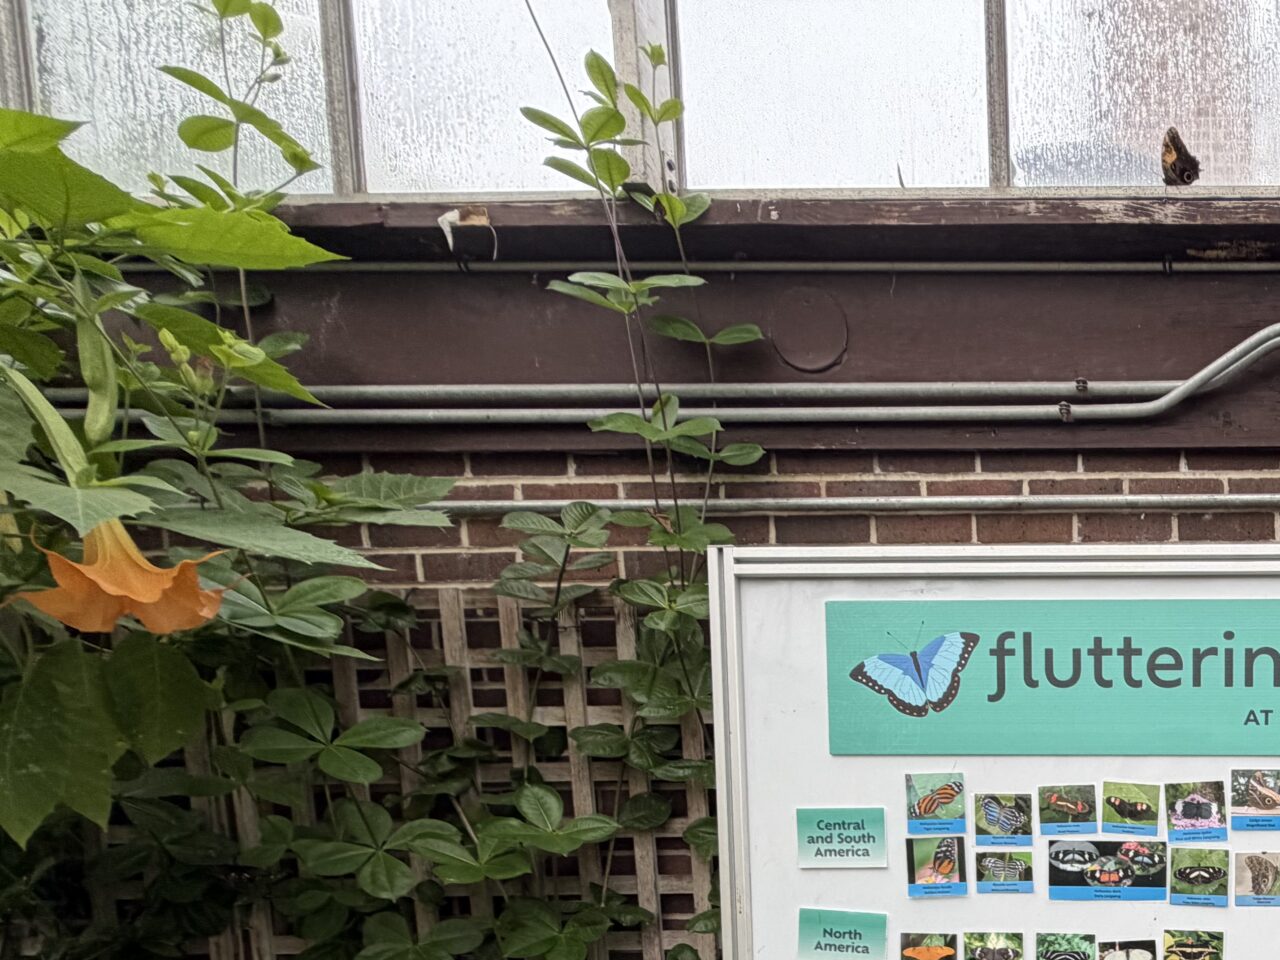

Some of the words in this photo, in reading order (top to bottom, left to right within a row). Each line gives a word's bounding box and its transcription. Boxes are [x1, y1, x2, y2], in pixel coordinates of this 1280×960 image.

[1244, 709, 1274, 726] AT
[816, 819, 866, 831] Central
[807, 833, 833, 844] and
[837, 833, 876, 844] South
[814, 845, 870, 857] America
[822, 928, 862, 941] North
[814, 940, 870, 954] America
